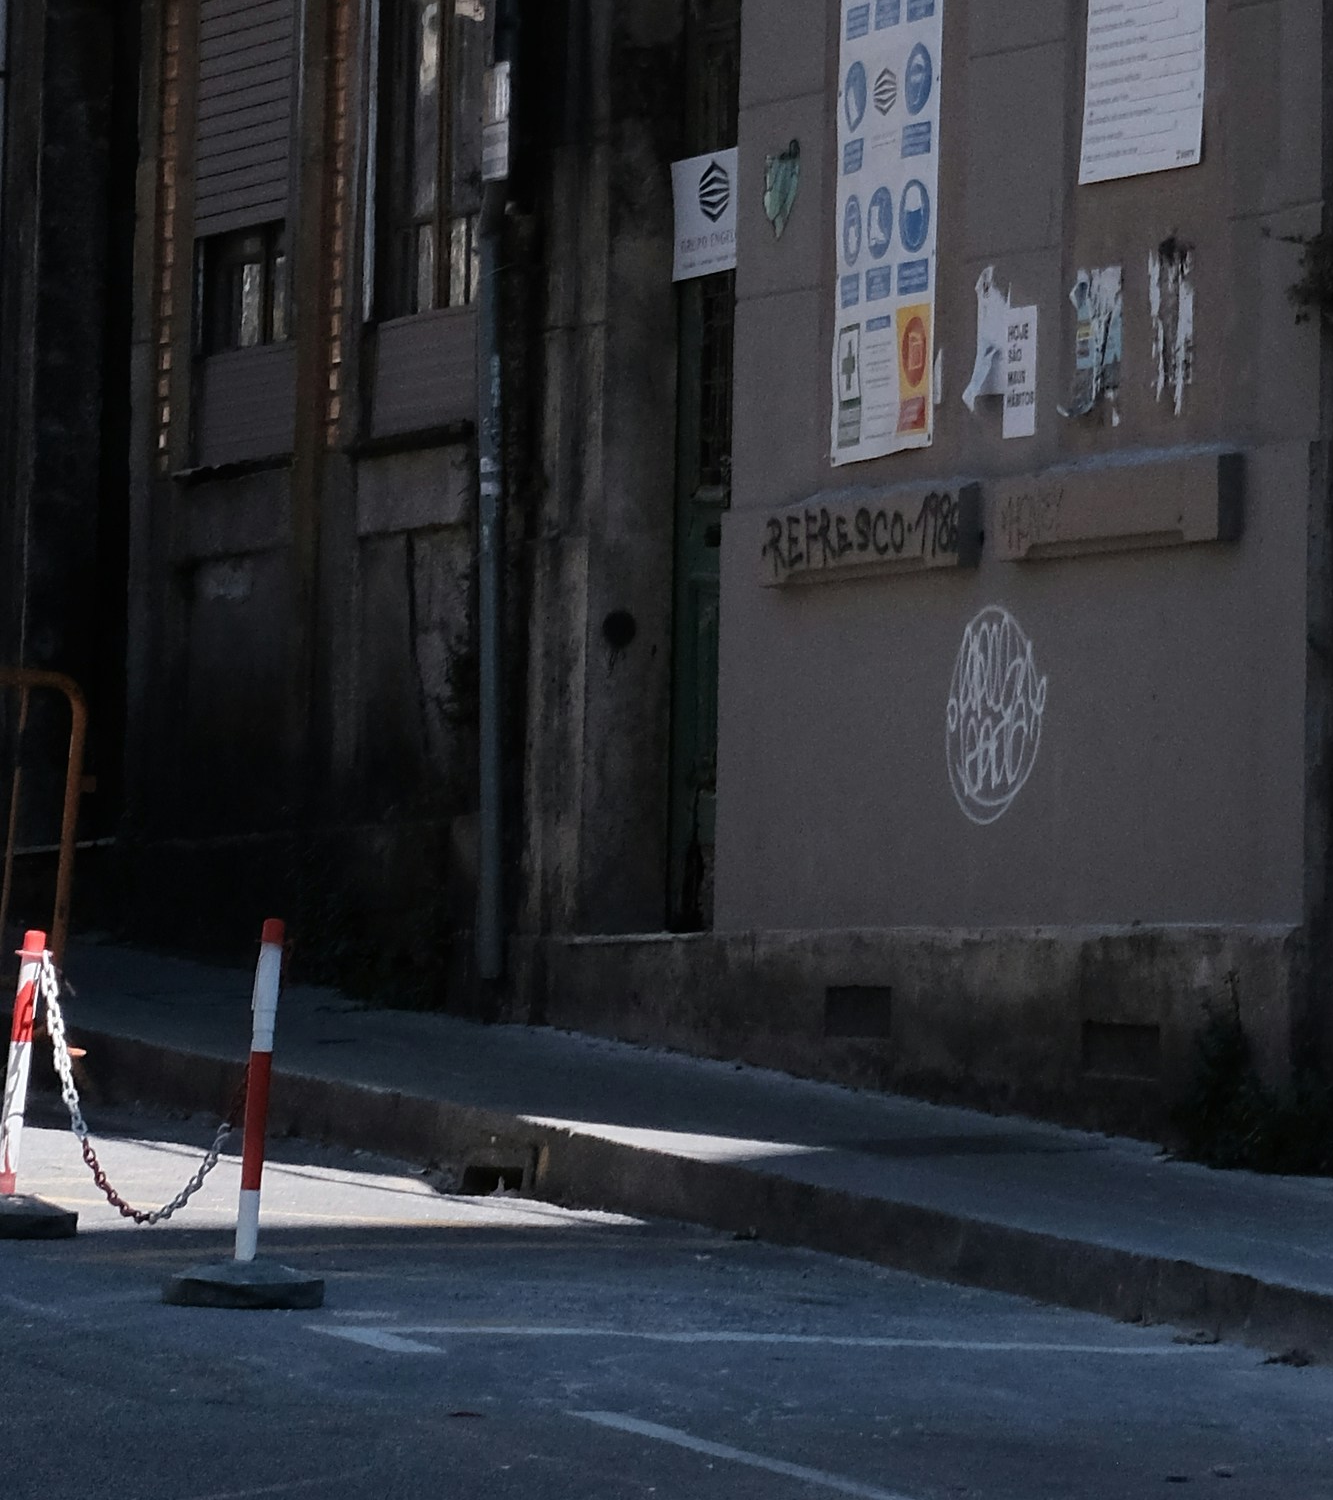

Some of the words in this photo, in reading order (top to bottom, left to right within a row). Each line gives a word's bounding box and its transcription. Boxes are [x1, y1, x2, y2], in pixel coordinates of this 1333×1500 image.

[1007, 322, 1029, 343] HOJE
[1008, 344, 1023, 364] SÃO
[1006, 388, 1035, 409] HÁBITOS
